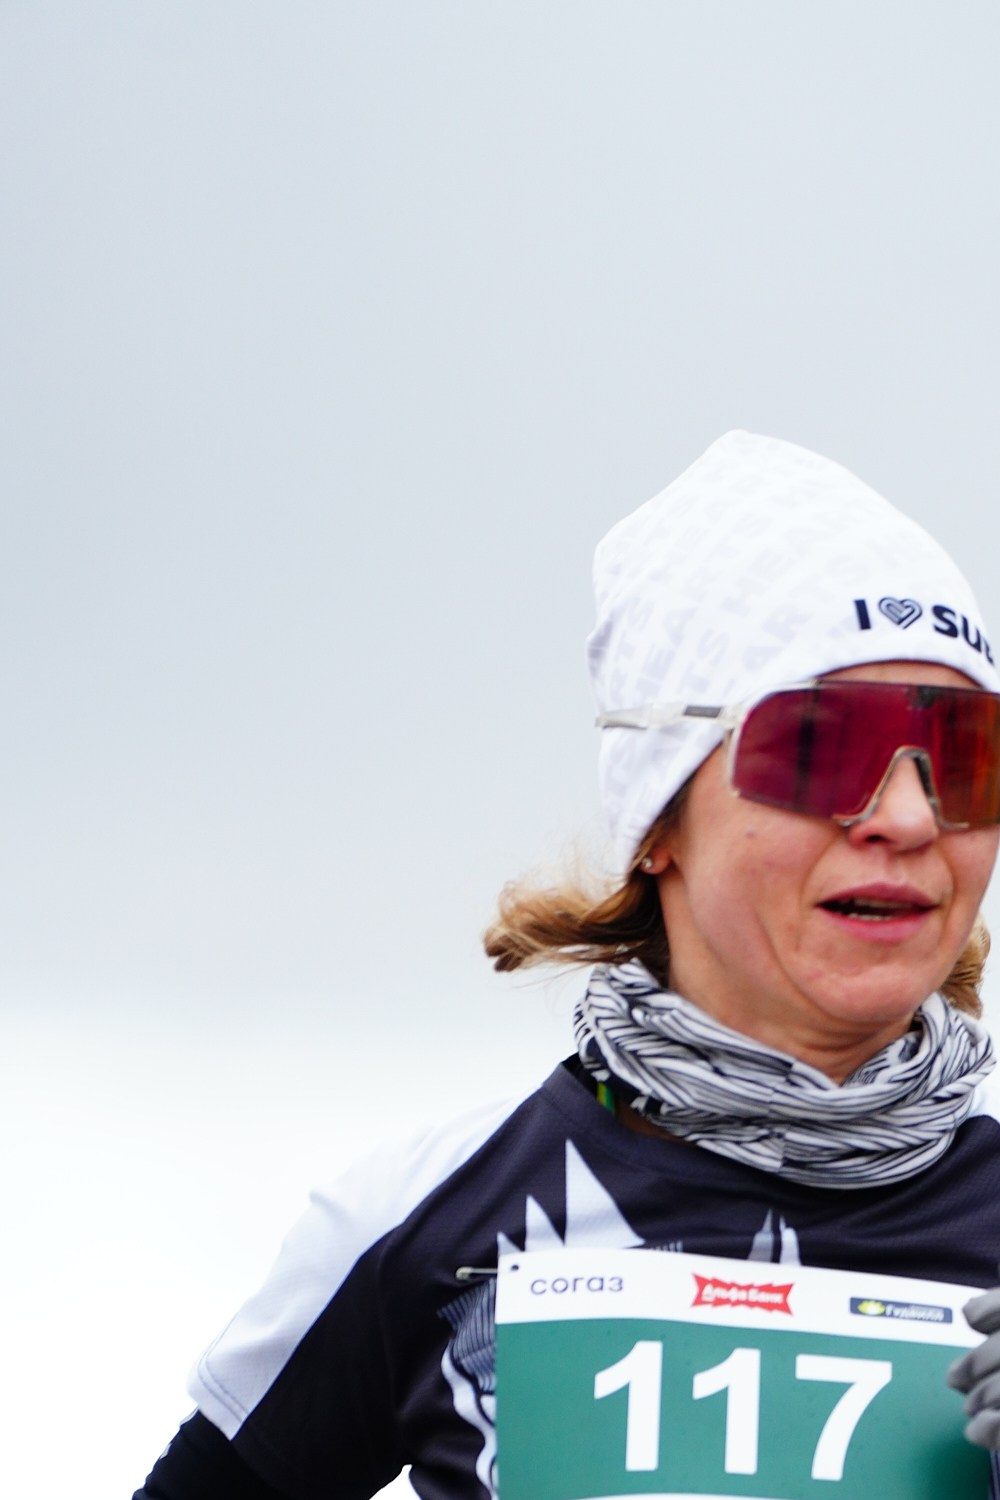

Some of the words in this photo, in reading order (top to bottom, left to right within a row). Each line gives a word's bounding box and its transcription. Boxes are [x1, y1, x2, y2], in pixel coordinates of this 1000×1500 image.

[853, 599, 872, 631] I
[529, 1275, 625, 1296] согаз
[594, 1340, 893, 1482] 117
